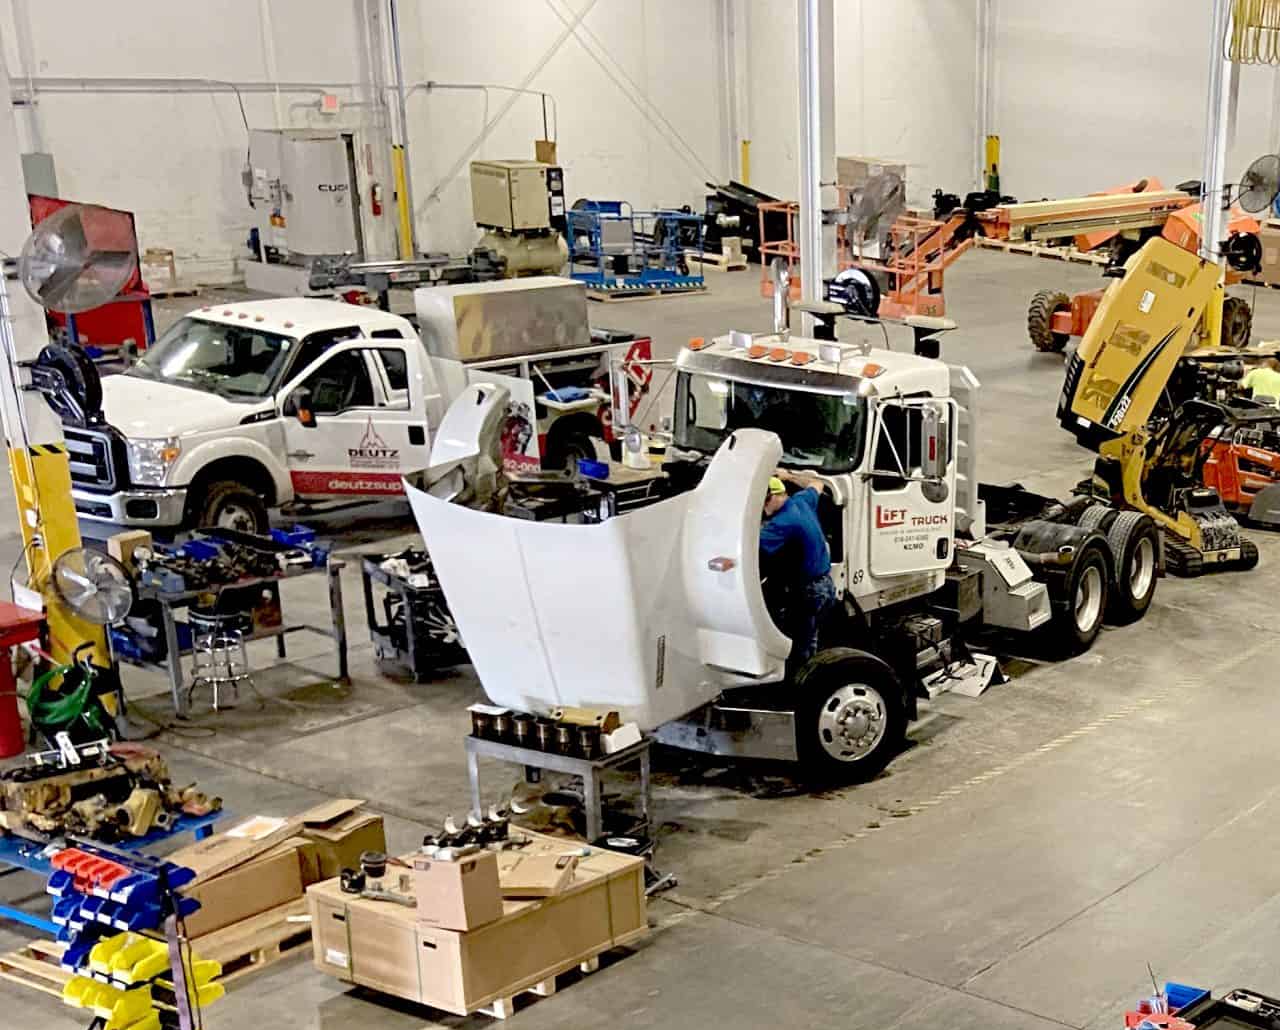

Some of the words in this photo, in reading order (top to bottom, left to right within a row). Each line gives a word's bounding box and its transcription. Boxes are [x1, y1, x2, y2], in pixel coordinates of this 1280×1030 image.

[347, 448, 399, 457] DEUTZ
[911, 514, 948, 527] TRUCK
[853, 569, 864, 584] 69
